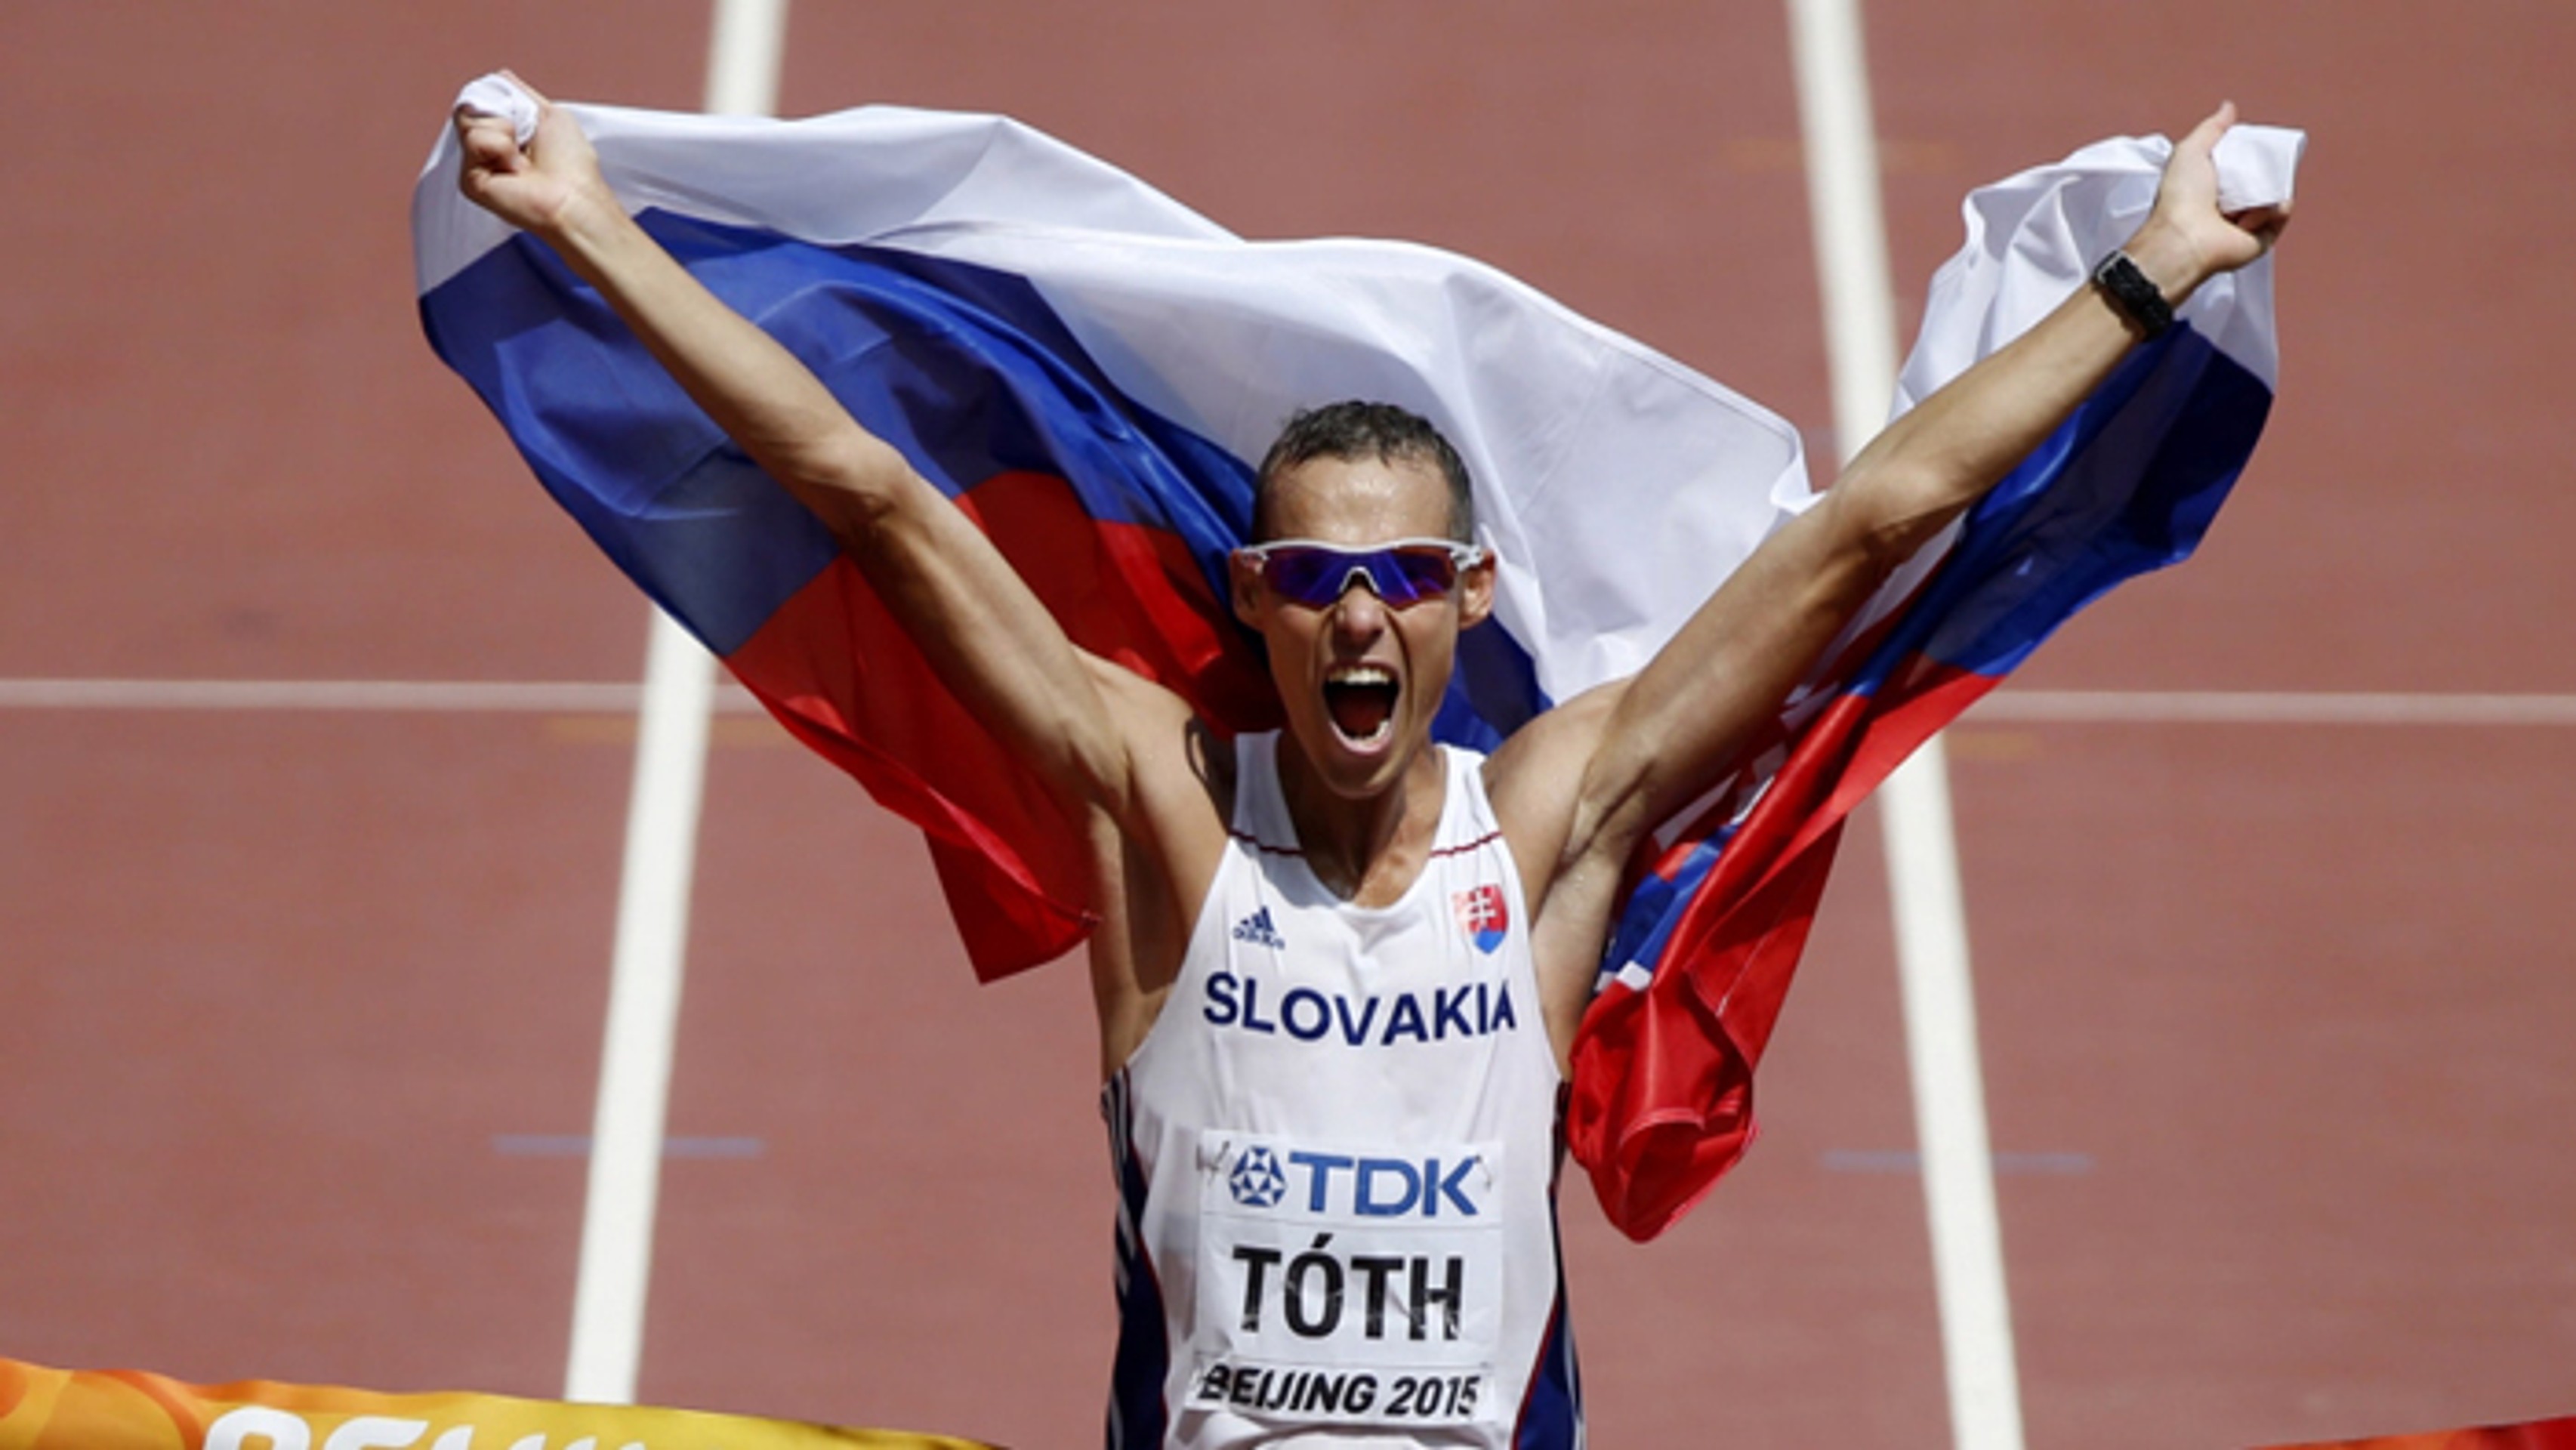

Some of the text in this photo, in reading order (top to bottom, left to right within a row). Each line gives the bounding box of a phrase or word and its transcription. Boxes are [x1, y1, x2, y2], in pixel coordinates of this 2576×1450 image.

[1203, 970, 1517, 1047] SLOVAKIA
[1288, 1150, 1479, 1217] TDK
[1232, 1232, 1464, 1341] TÓTH
[1198, 1363, 1482, 1418] BEIJING 2015
